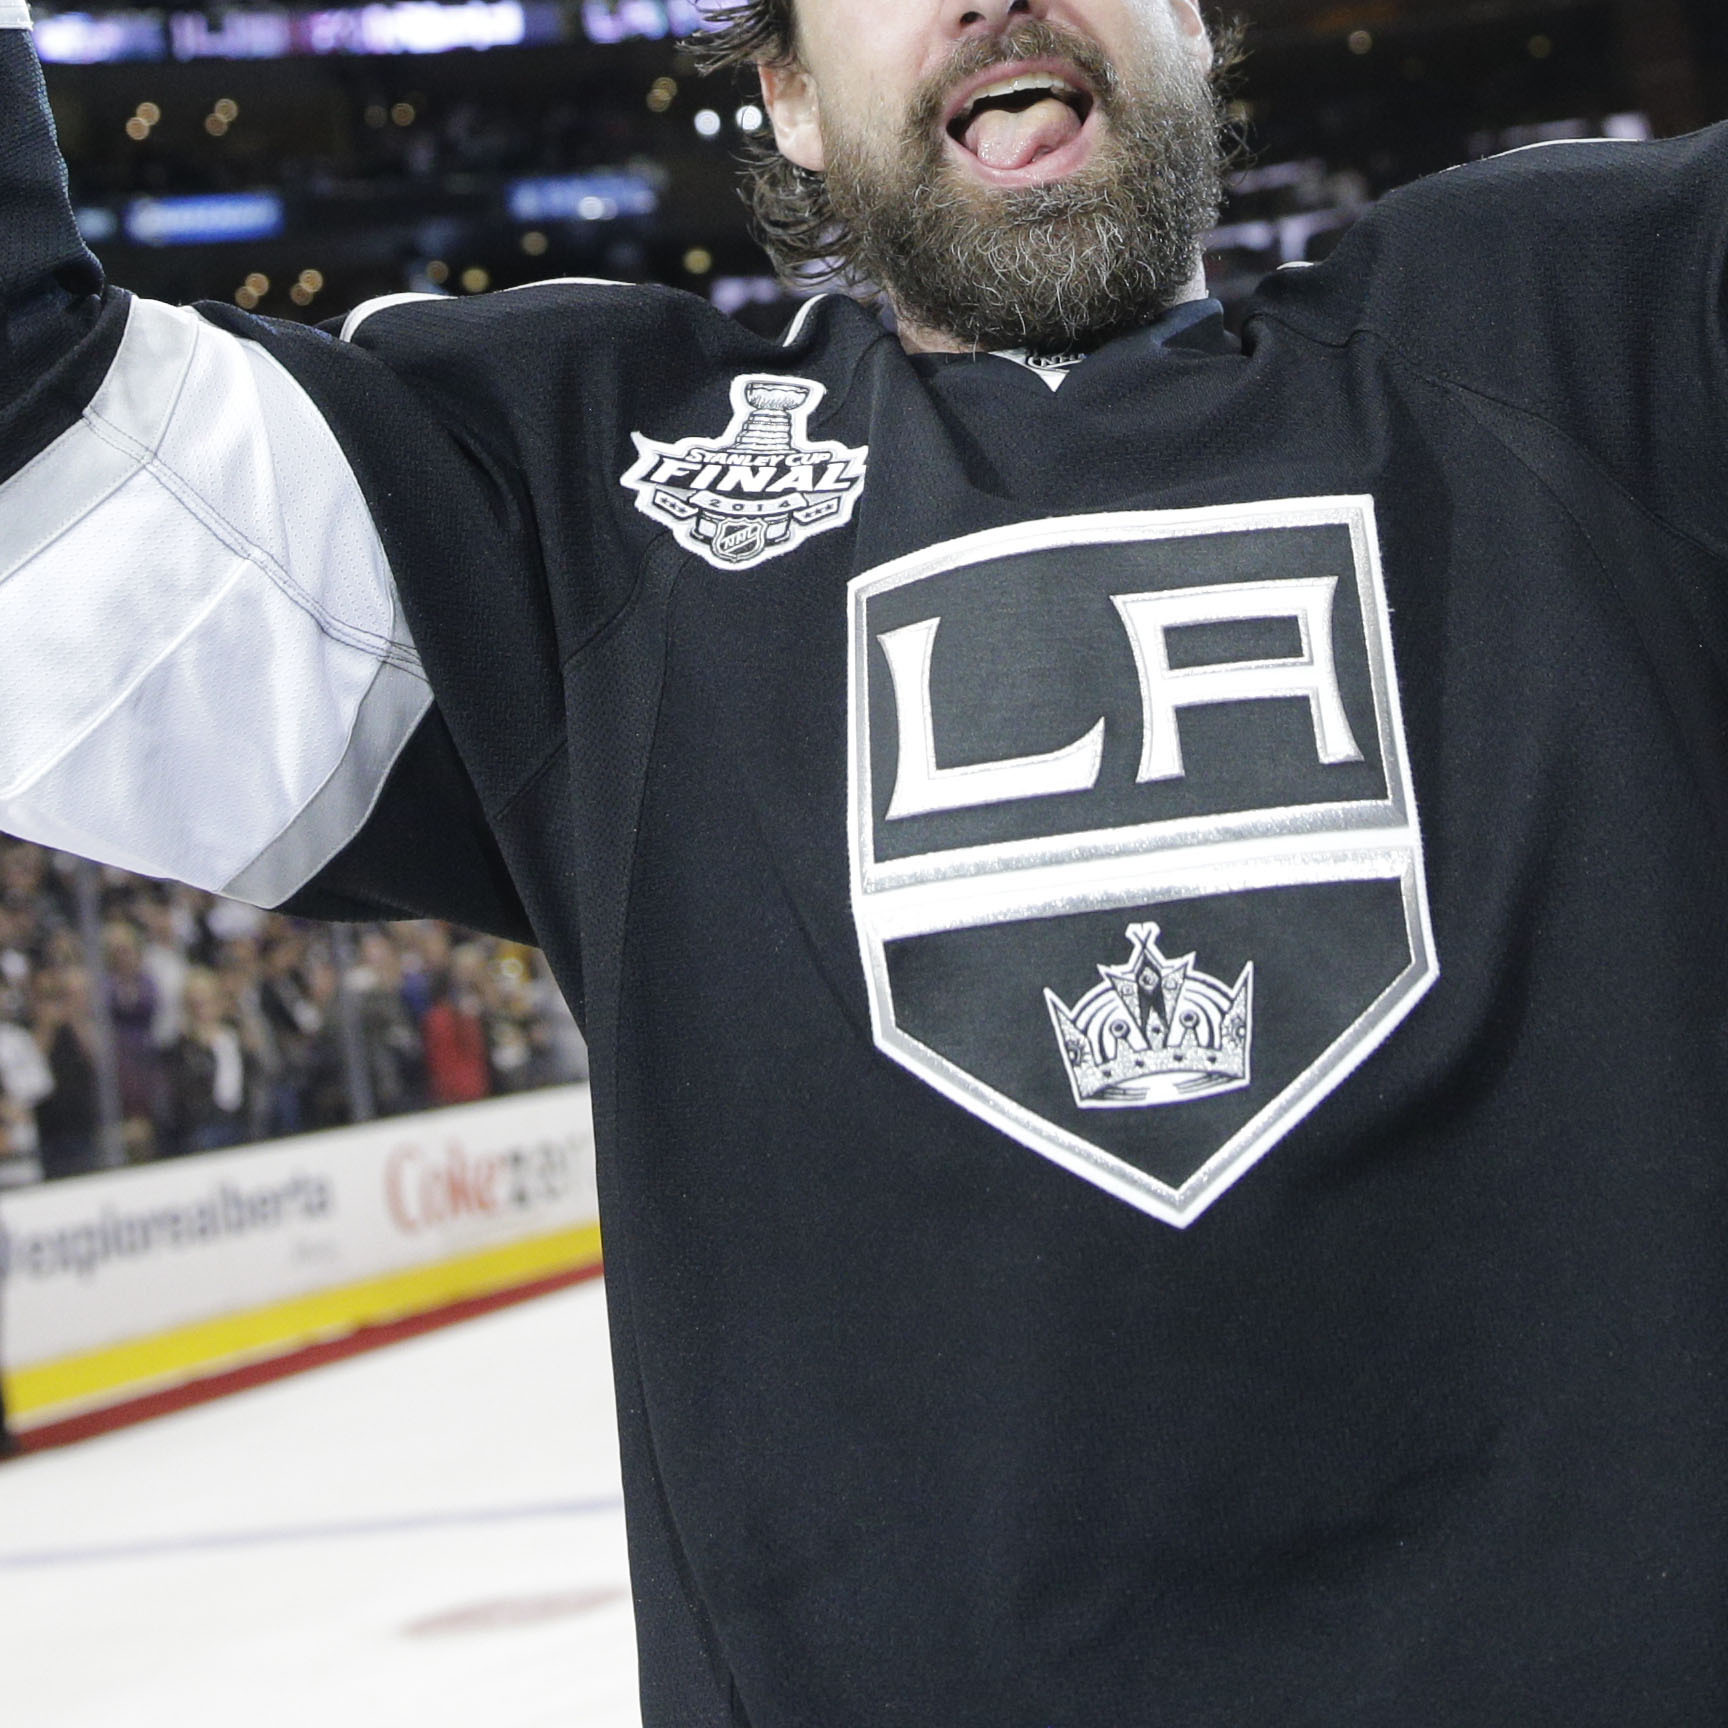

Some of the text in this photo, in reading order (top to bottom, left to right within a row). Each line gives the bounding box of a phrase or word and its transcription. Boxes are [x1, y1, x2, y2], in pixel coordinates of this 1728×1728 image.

[685, 448, 832, 468] STANLEY CUP
[649, 456, 852, 493] FINAL
[709, 497, 793, 513] 2014
[721, 524, 760, 553] NHL
[876, 574, 1366, 822] LA
